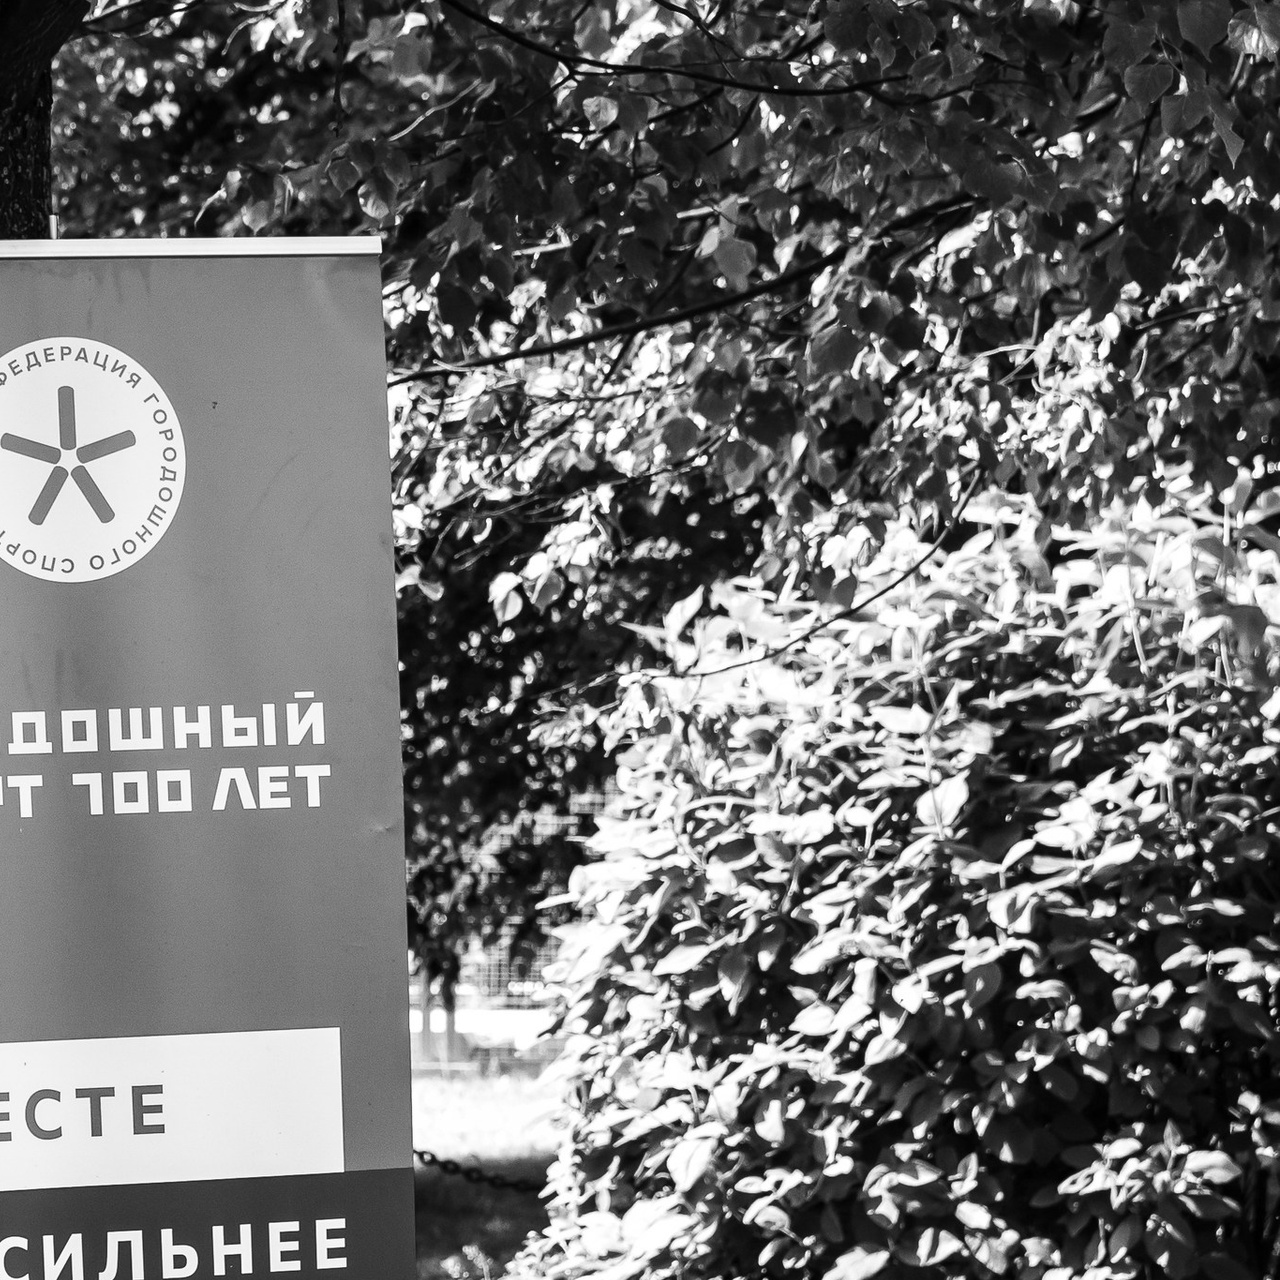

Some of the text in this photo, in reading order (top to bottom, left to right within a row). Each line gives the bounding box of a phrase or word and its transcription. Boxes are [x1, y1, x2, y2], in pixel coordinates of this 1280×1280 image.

[89, 392, 178, 571] ГОРОДОШНОГО
[72, 769, 193, 815] 100
[212, 764, 332, 811] ЛЕТ
